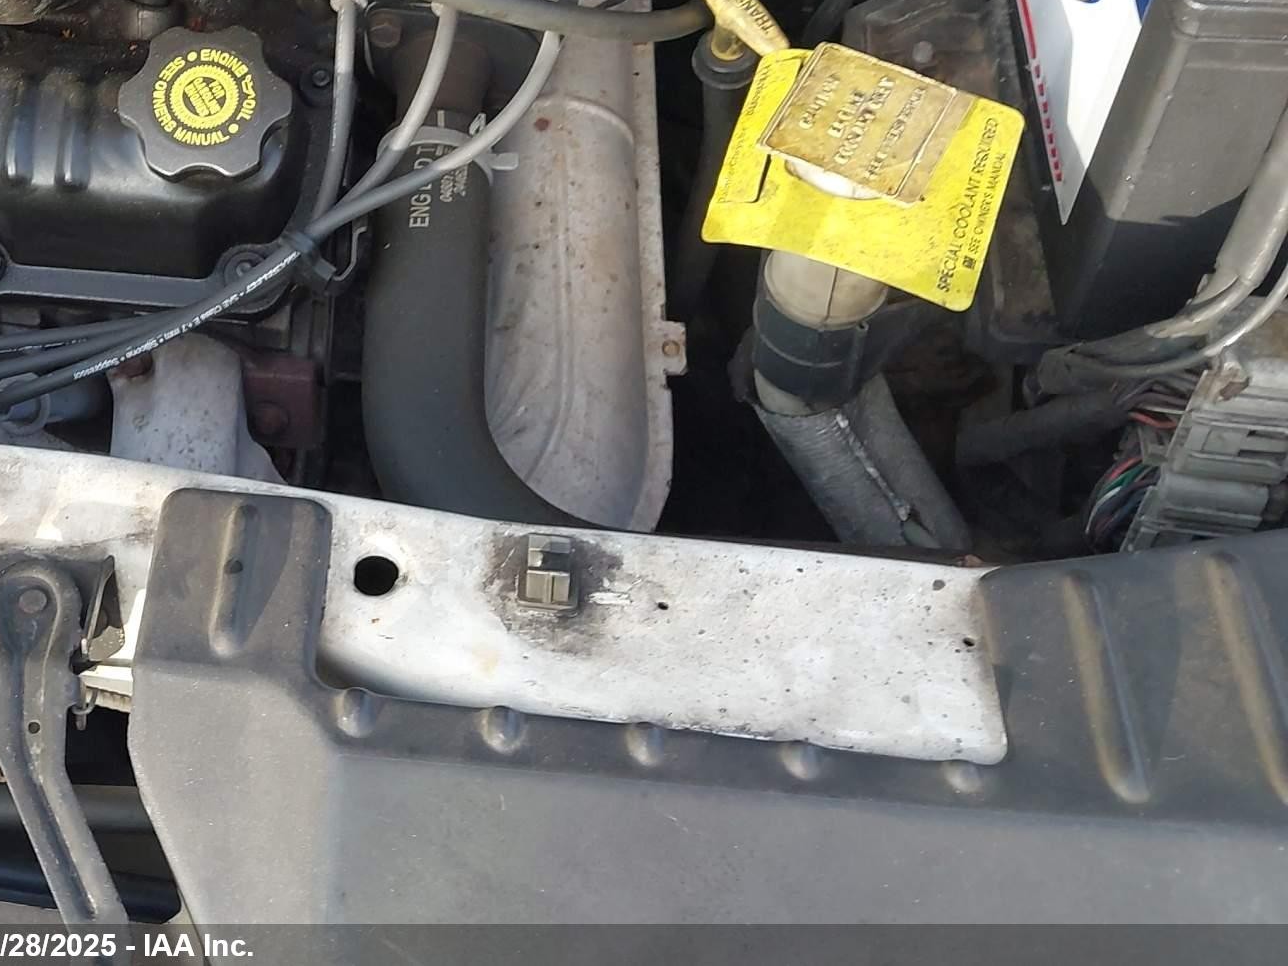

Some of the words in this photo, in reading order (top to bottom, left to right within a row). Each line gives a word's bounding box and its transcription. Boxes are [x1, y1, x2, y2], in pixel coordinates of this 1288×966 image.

[158, 56, 186, 82] SEE
[200, 49, 249, 78] ENGINE
[236, 98, 256, 121] OIL
[152, 80, 178, 133] OWNERS
[173, 127, 230, 146] MANUAL
[937, 242, 963, 293] SPECIAL
[951, 177, 981, 241] COOLANT
